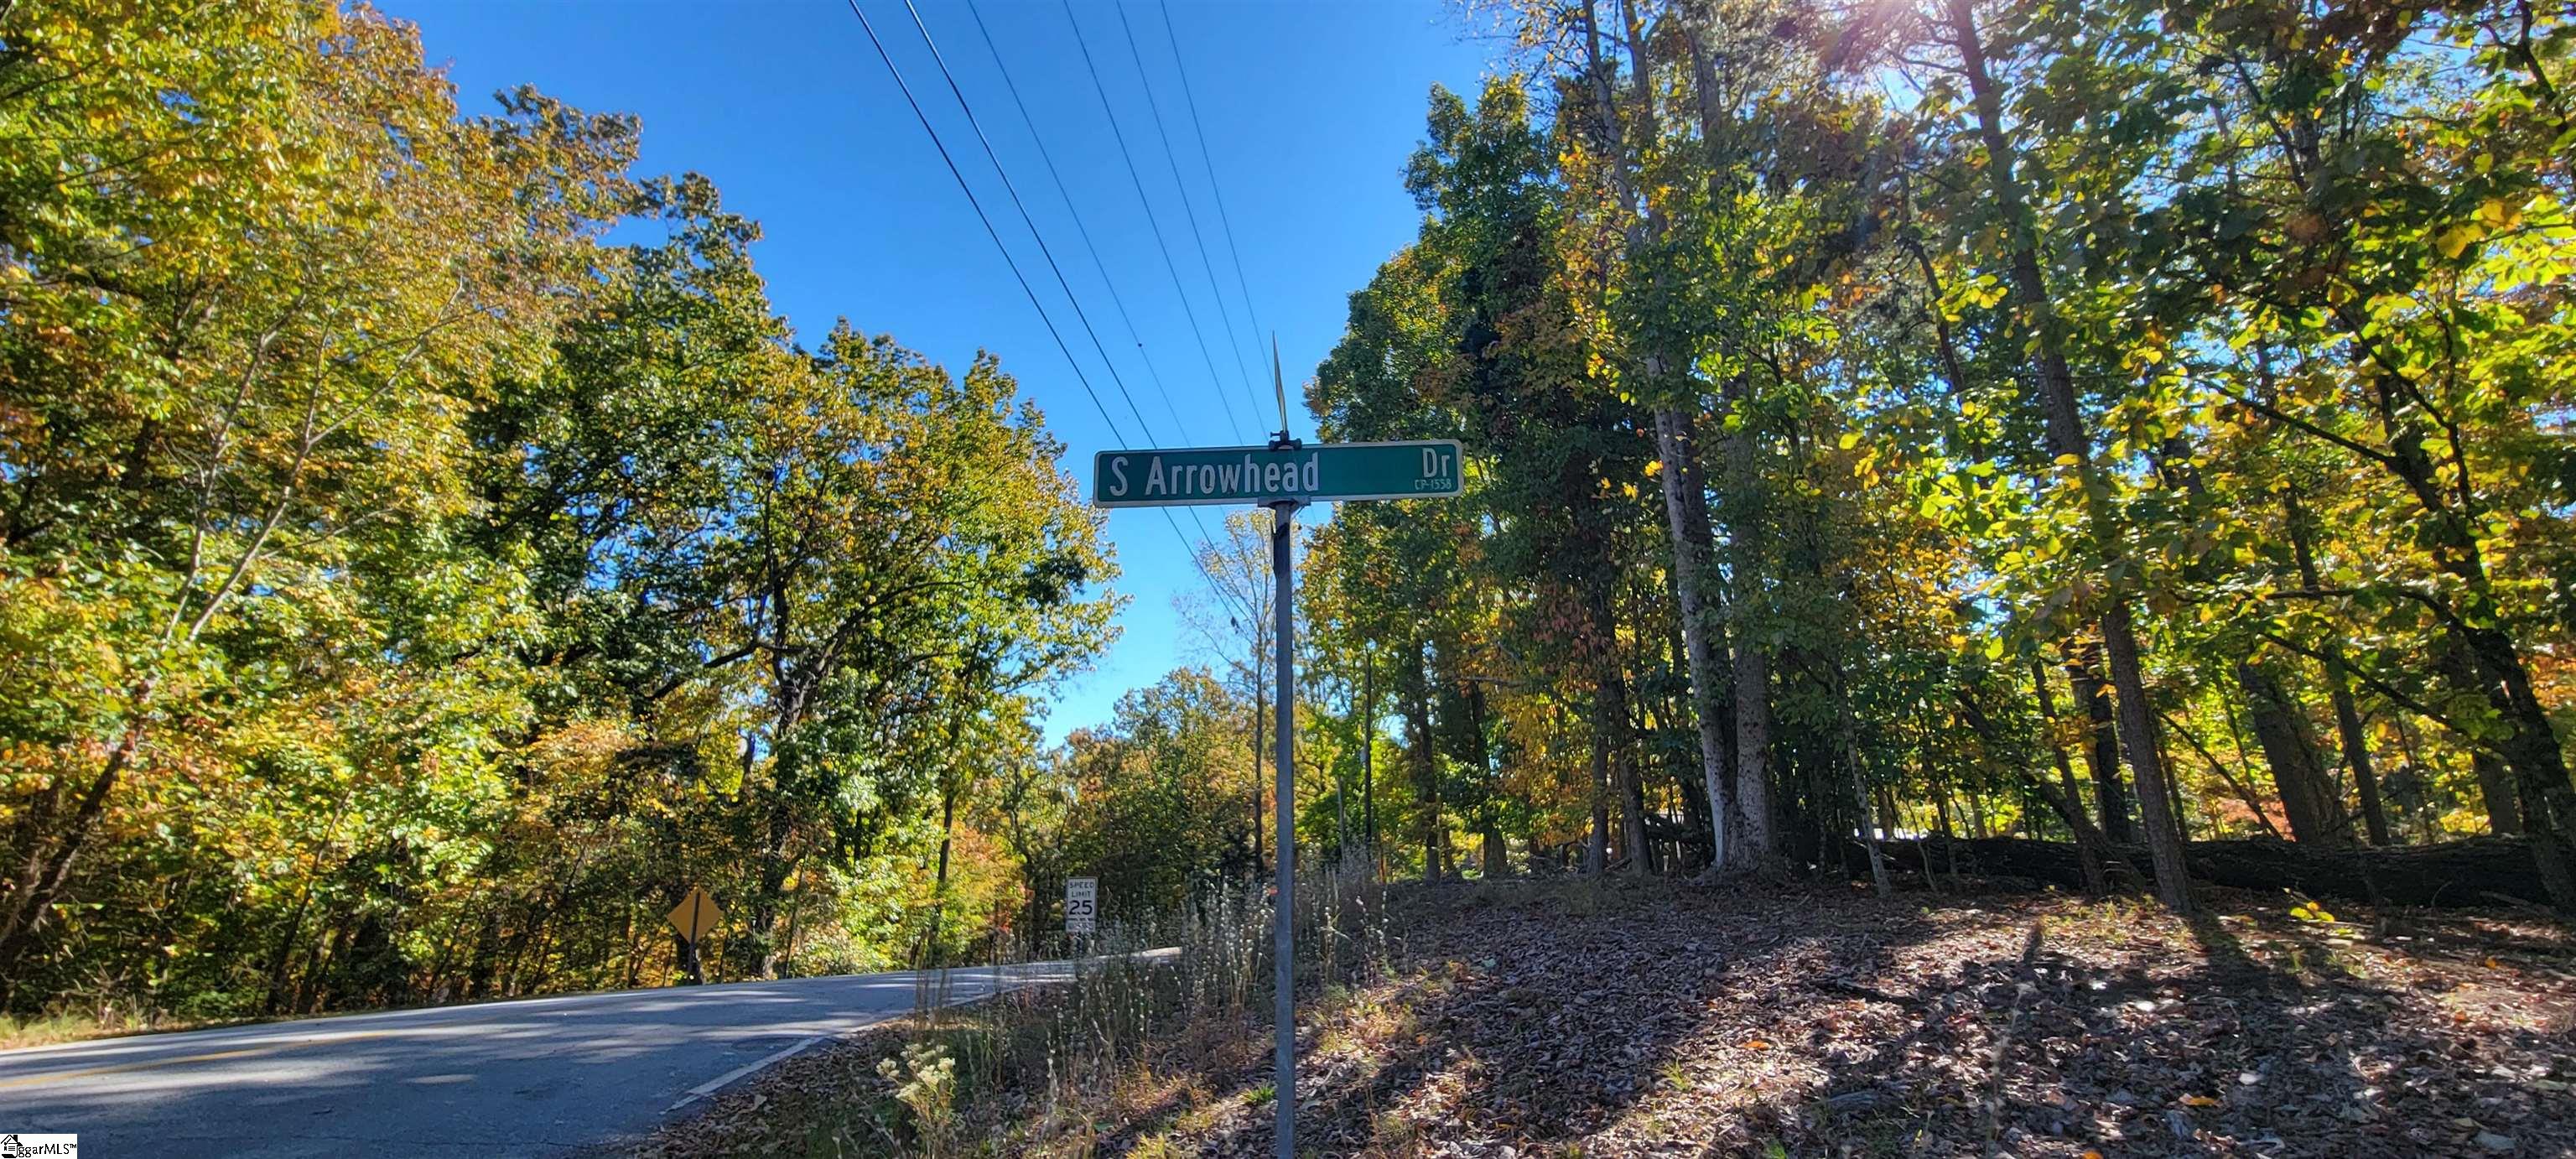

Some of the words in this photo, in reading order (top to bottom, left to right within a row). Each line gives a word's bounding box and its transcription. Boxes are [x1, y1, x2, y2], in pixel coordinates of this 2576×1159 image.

[1109, 456, 1129, 496] S
[1145, 452, 1319, 496] Arrowhead
[1422, 448, 1450, 477] Dr
[1069, 900, 1093, 915] 25
